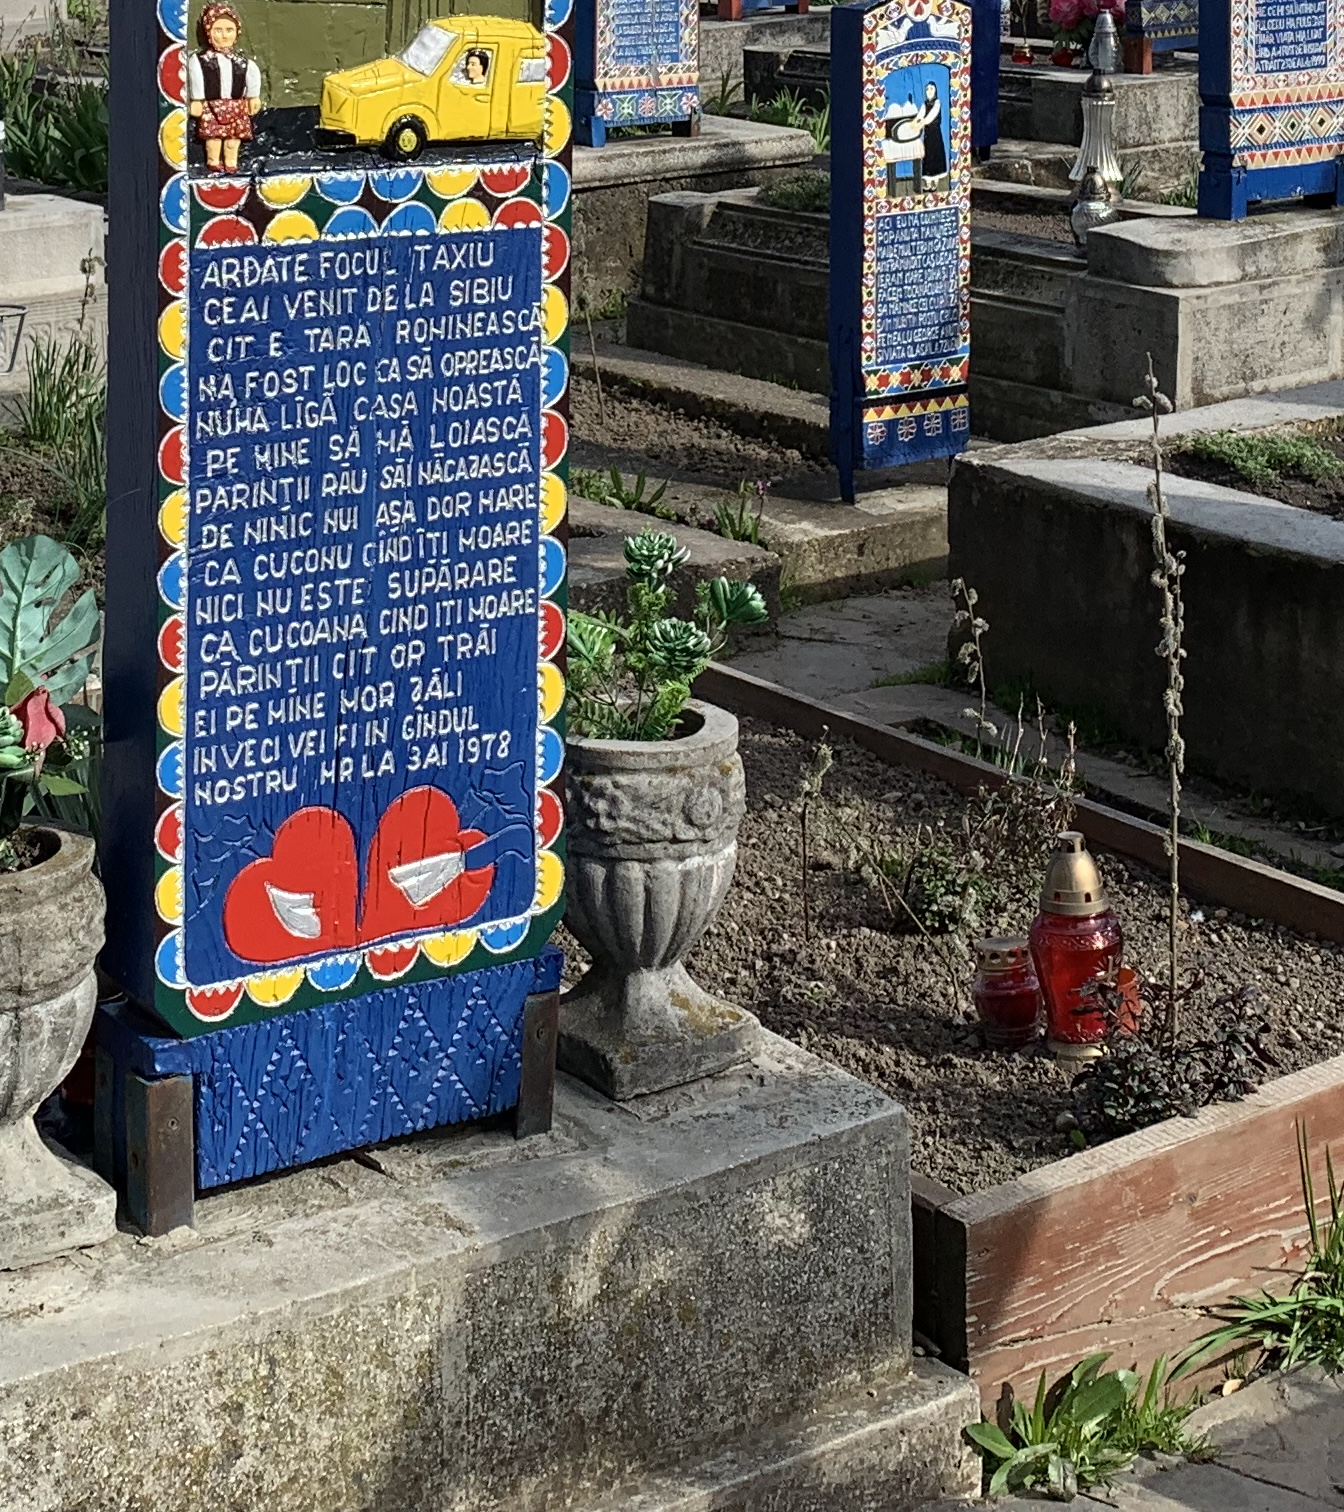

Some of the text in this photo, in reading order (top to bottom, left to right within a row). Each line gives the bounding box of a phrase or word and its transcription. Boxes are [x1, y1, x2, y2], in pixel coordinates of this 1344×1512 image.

[413, 241, 494, 271] TAXIU
[284, 288, 358, 320] VENIT
[449, 275, 513, 306] SIBIU
[269, 331, 283, 357] E
[245, 365, 315, 398] FOST
[323, 360, 366, 389] LOC
[354, 389, 418, 421] CASA
[206, 447, 240, 478] PE
[201, 523, 234, 550] DE
[427, 491, 472, 522] DOR
[205, 558, 242, 586] CA
[458, 519, 533, 552] MOARE
[256, 587, 292, 617] NU
[301, 578, 365, 612] ESTE
[391, 639, 425, 671] OR
[194, 708, 216, 737] EI
[226, 702, 260, 732] PE
[288, 728, 325, 758] VEI
[334, 723, 357, 750] FI
[195, 764, 297, 806] NOSTRU
[362, 749, 395, 778] LA
[458, 730, 511, 763] 1978
